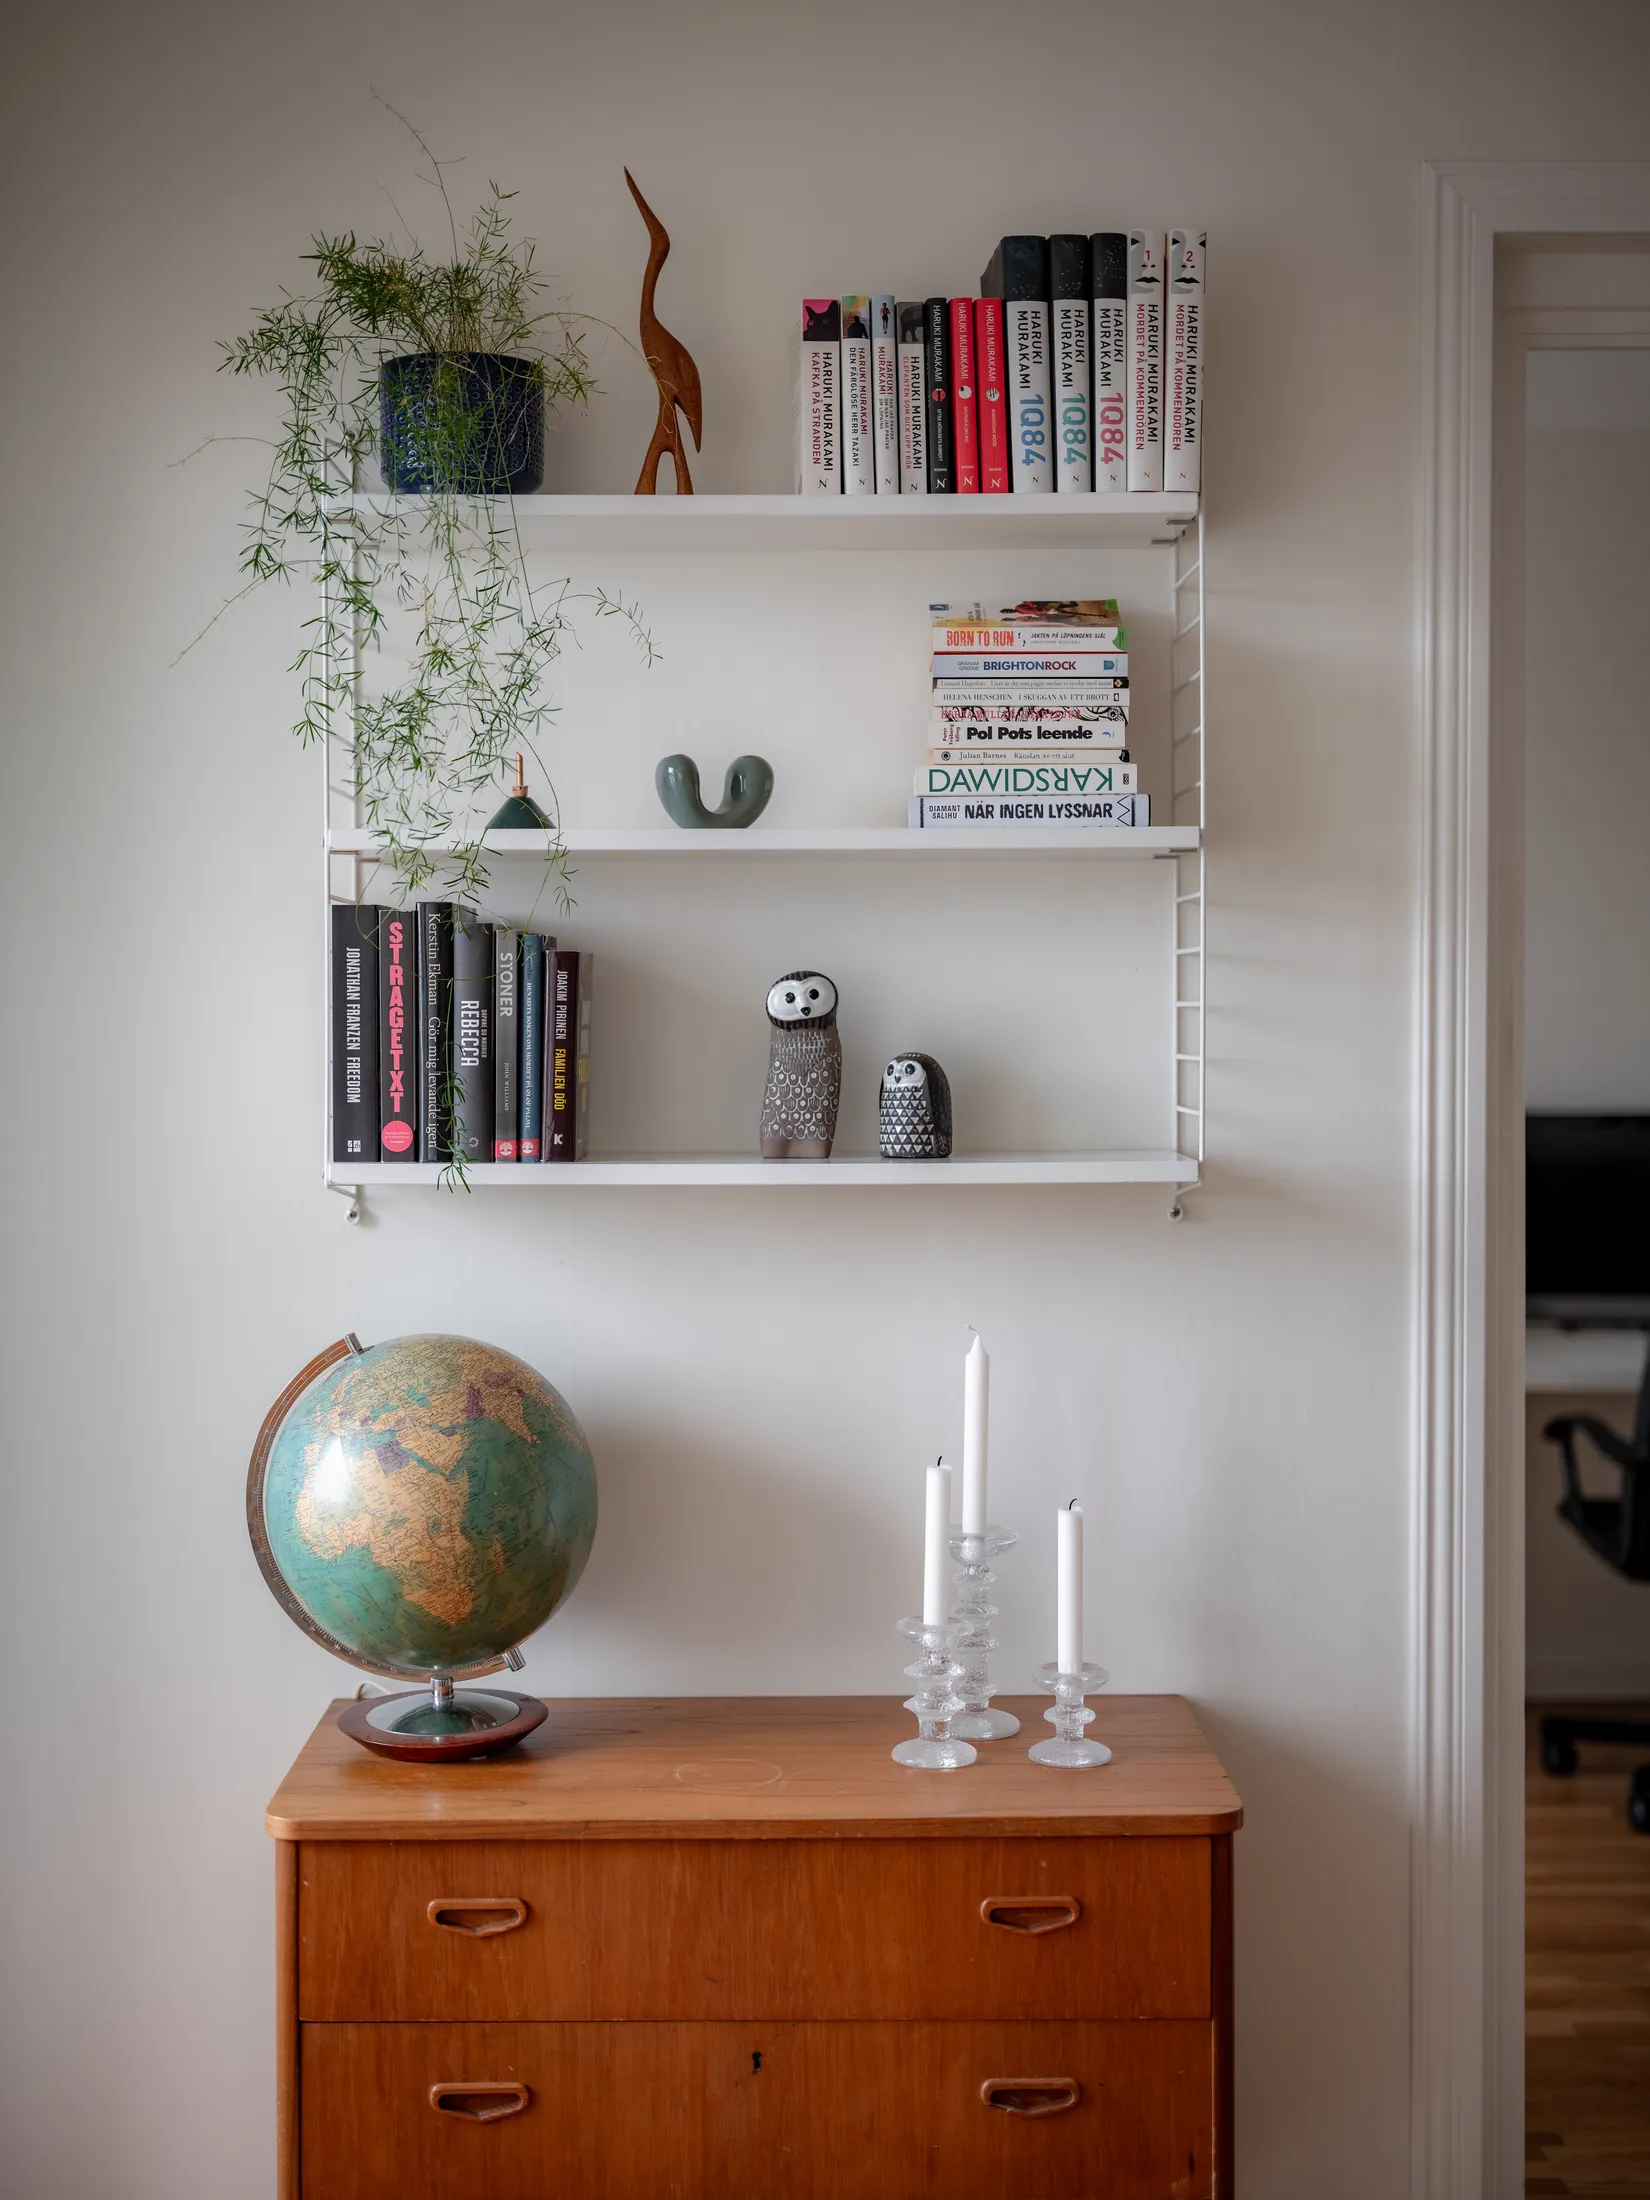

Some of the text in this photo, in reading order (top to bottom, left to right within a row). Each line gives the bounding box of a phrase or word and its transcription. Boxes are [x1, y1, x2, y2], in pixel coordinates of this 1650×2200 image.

[1145, 250, 1150, 261] 1
[1186, 250, 1193, 262] 2
[878, 346, 894, 395] HARUKI MURAKAMI
[933, 305, 942, 382] HARUKI MURAKAMI
[958, 302, 968, 379] HARUKI MURAKAMI
[985, 305, 996, 382] HARUKI MURAKAMI
[1017, 310, 1031, 389] MURAKAMI
[1031, 310, 1043, 364] HARUKI
[1061, 309, 1073, 388] MURAKAMI
[1074, 309, 1085, 363] HARUKI
[1100, 308, 1112, 387] MURAKAMI
[1113, 308, 1124, 363] HARUKI
[1147, 304, 1159, 443] HARUKI MURAKAMI
[1184, 304, 1198, 443] HARUKI MURAKAMI
[811, 352, 824, 465] KAFKA PÅ STRANDEN
[822, 352, 834, 471] HARUKI MURAKAMI
[849, 347, 860, 467] DEN FÄRGLÖSE HERR TAZAKI
[858, 347, 868, 435] HARUKI MURAKAMI
[911, 356, 922, 469] HARUKI MURAKAMI
[1135, 303, 1147, 450] MORDET PÅ KOMMENDÖREN
[1172, 304, 1186, 451] MORDET PÅ KOMMENDÖREN
[1019, 394, 1046, 466] 1Q84
[1062, 392, 1087, 465] 1Q84
[1100, 392, 1124, 465] 1Q84
[946, 631, 1014, 647] BORN TO RUN
[959, 752, 981, 760] Julian
[967, 726, 1093, 740] Pol Pots leende
[965, 800, 1113, 819] NÄR INGEN LYSSNAR
[500, 952, 513, 1017] STONER
[346, 947, 361, 1103] JONATHAN FRANZEN FREEDOM
[425, 912, 442, 1148] Kerstin Ekman Gör mig levande igen
[460, 1000, 480, 1067] REBECCA
[526, 1039, 532, 1050] OM
[553, 970, 568, 1110] JOAKIM PIRINEN FAMILJEN DÖD
